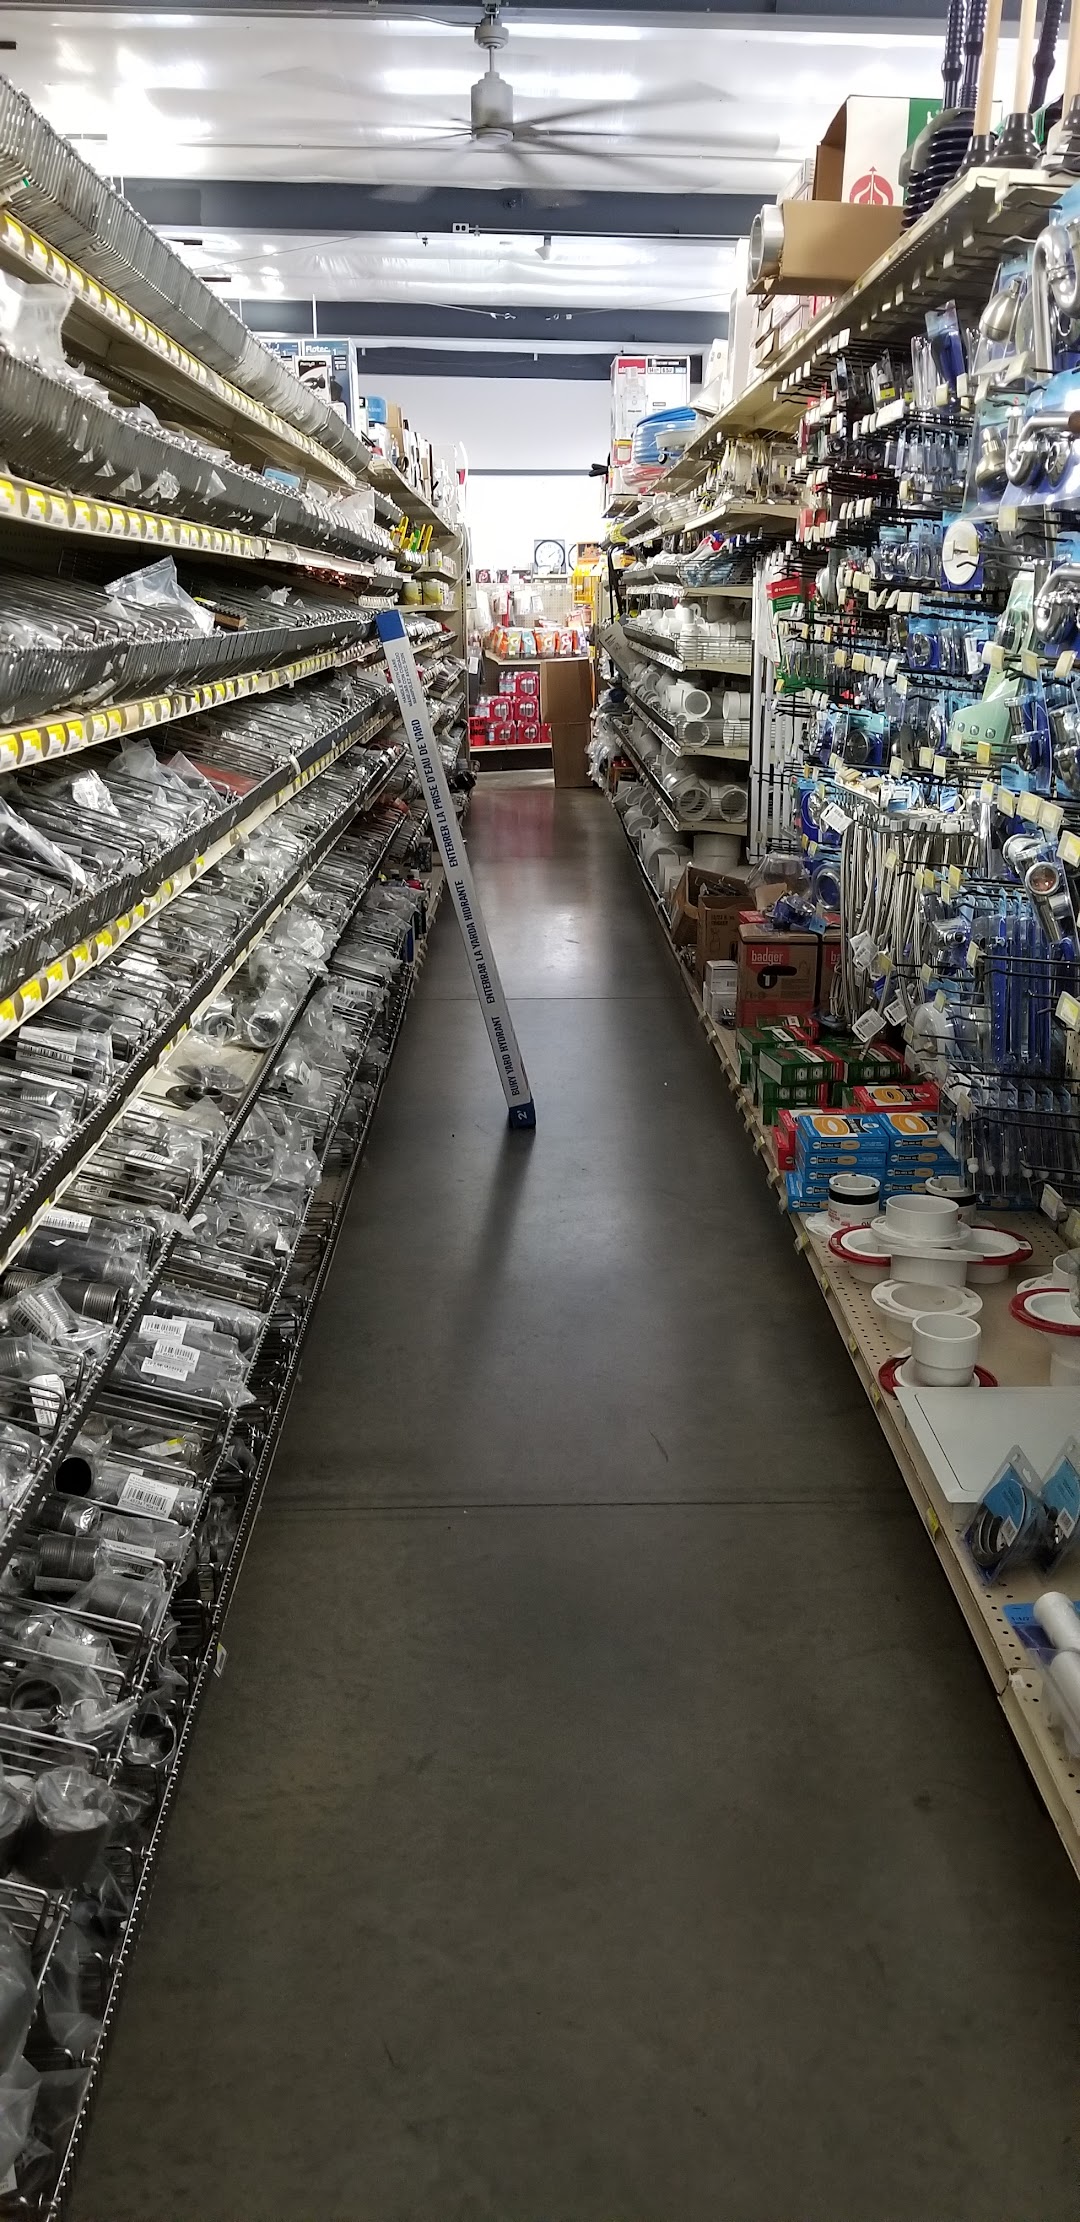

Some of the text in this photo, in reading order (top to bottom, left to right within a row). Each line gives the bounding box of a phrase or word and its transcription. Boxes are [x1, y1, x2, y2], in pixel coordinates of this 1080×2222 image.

[305, 345, 329, 353] Flotec
[561, 636, 571, 645] G
[411, 719, 459, 868] ENTERRER LA PRISE D'EAU DE YARD
[455, 880, 495, 1004] ENTERRAR LA YARDA HIDRANTE
[751, 947, 784, 966] badger
[491, 1016, 520, 1096] BURY YARD HYDRANT
